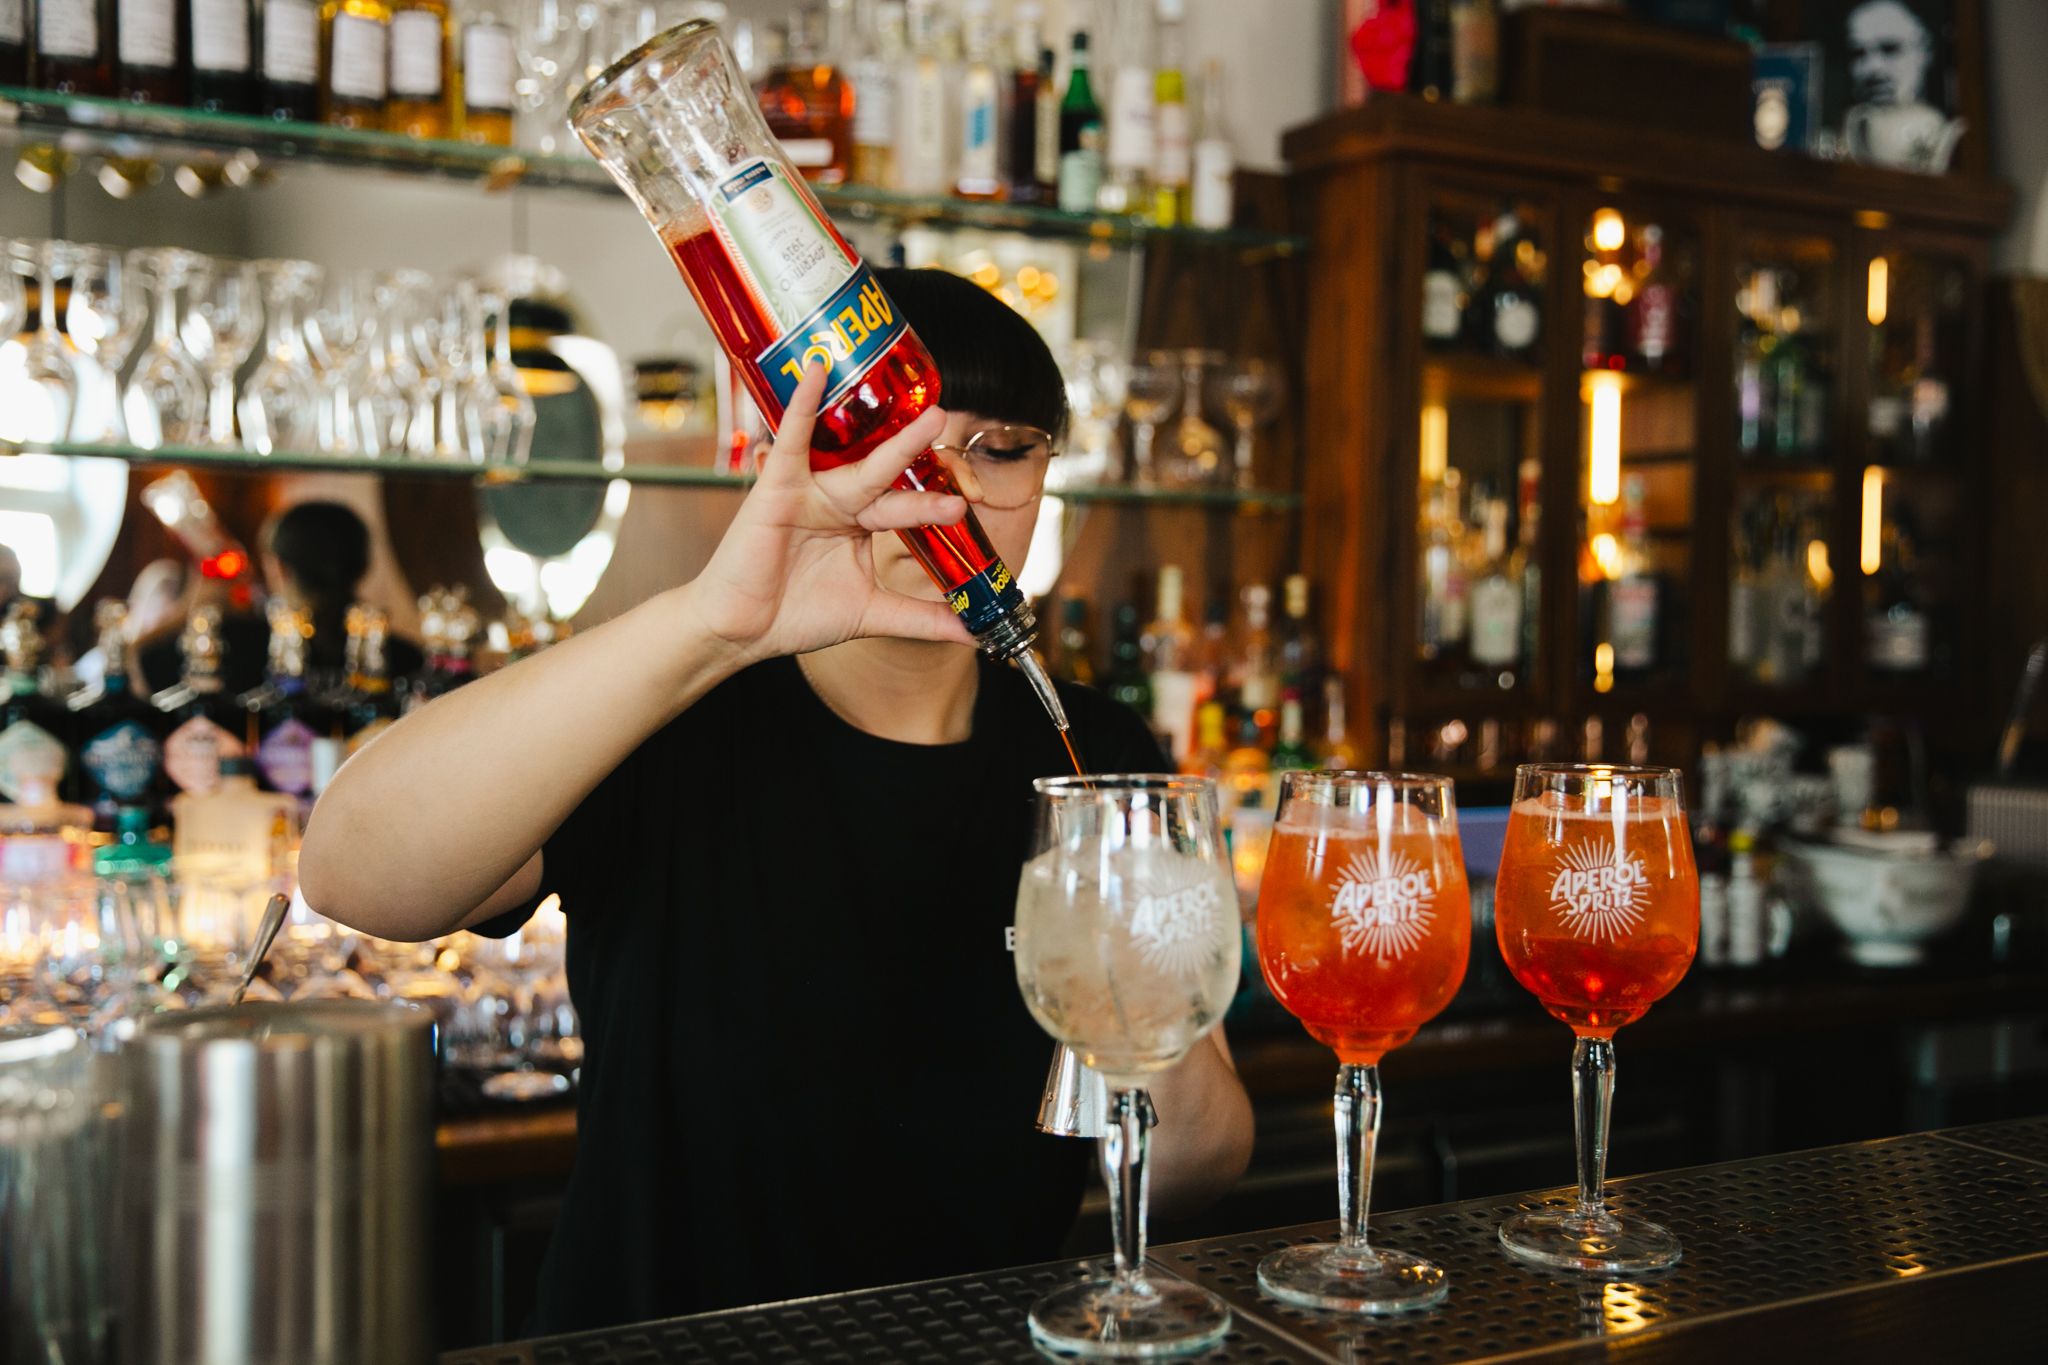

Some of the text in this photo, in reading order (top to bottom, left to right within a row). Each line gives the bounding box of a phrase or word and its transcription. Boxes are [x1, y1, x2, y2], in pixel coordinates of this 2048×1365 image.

[780, 275, 894, 383] APEROL
[1331, 869, 1434, 918] APEROL
[1551, 860, 1648, 902] APEROL
